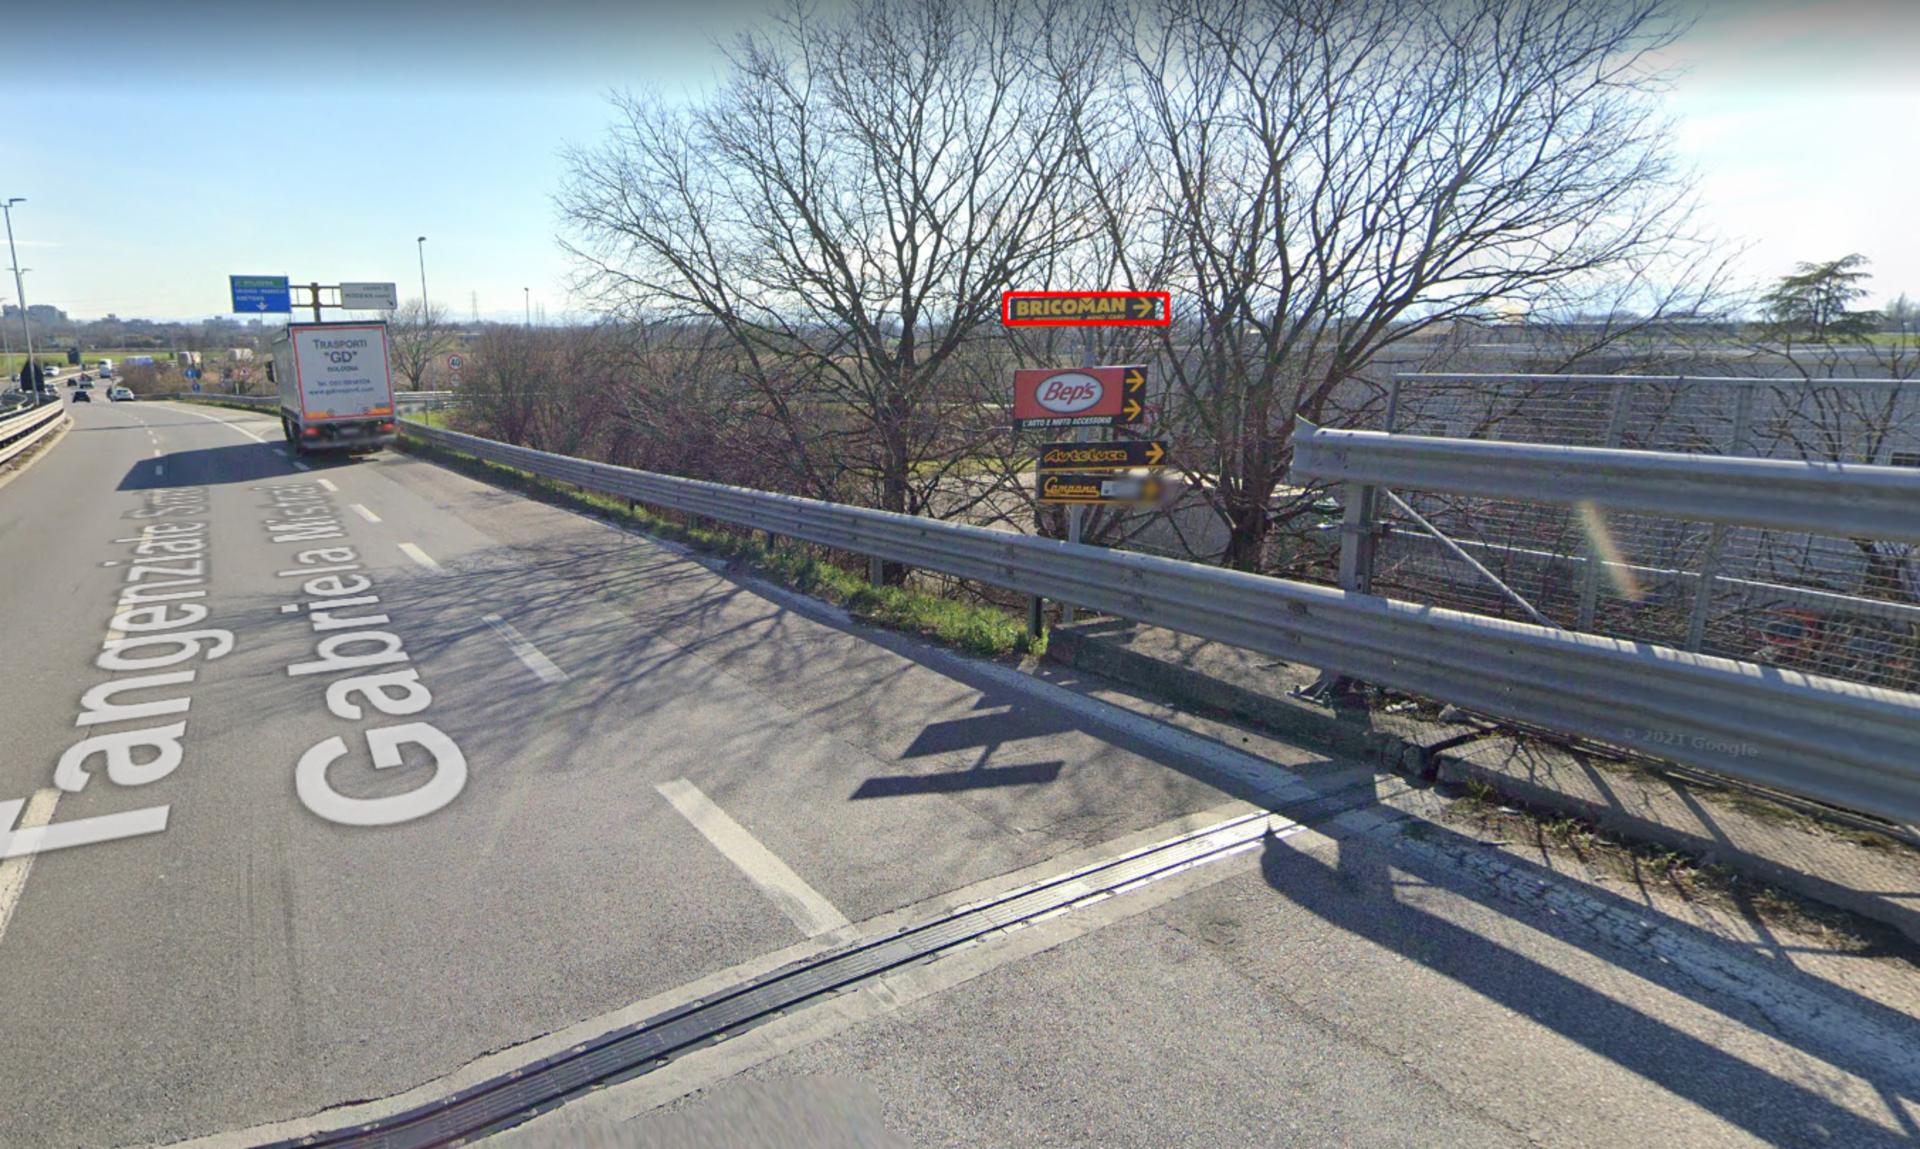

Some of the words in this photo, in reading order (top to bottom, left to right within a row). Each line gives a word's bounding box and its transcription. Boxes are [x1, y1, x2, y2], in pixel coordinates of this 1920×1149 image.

[1016, 298, 1126, 315] BRICOMAN
[324, 351, 358, 363] "GD"
[1043, 381, 1096, 405] Bep's
